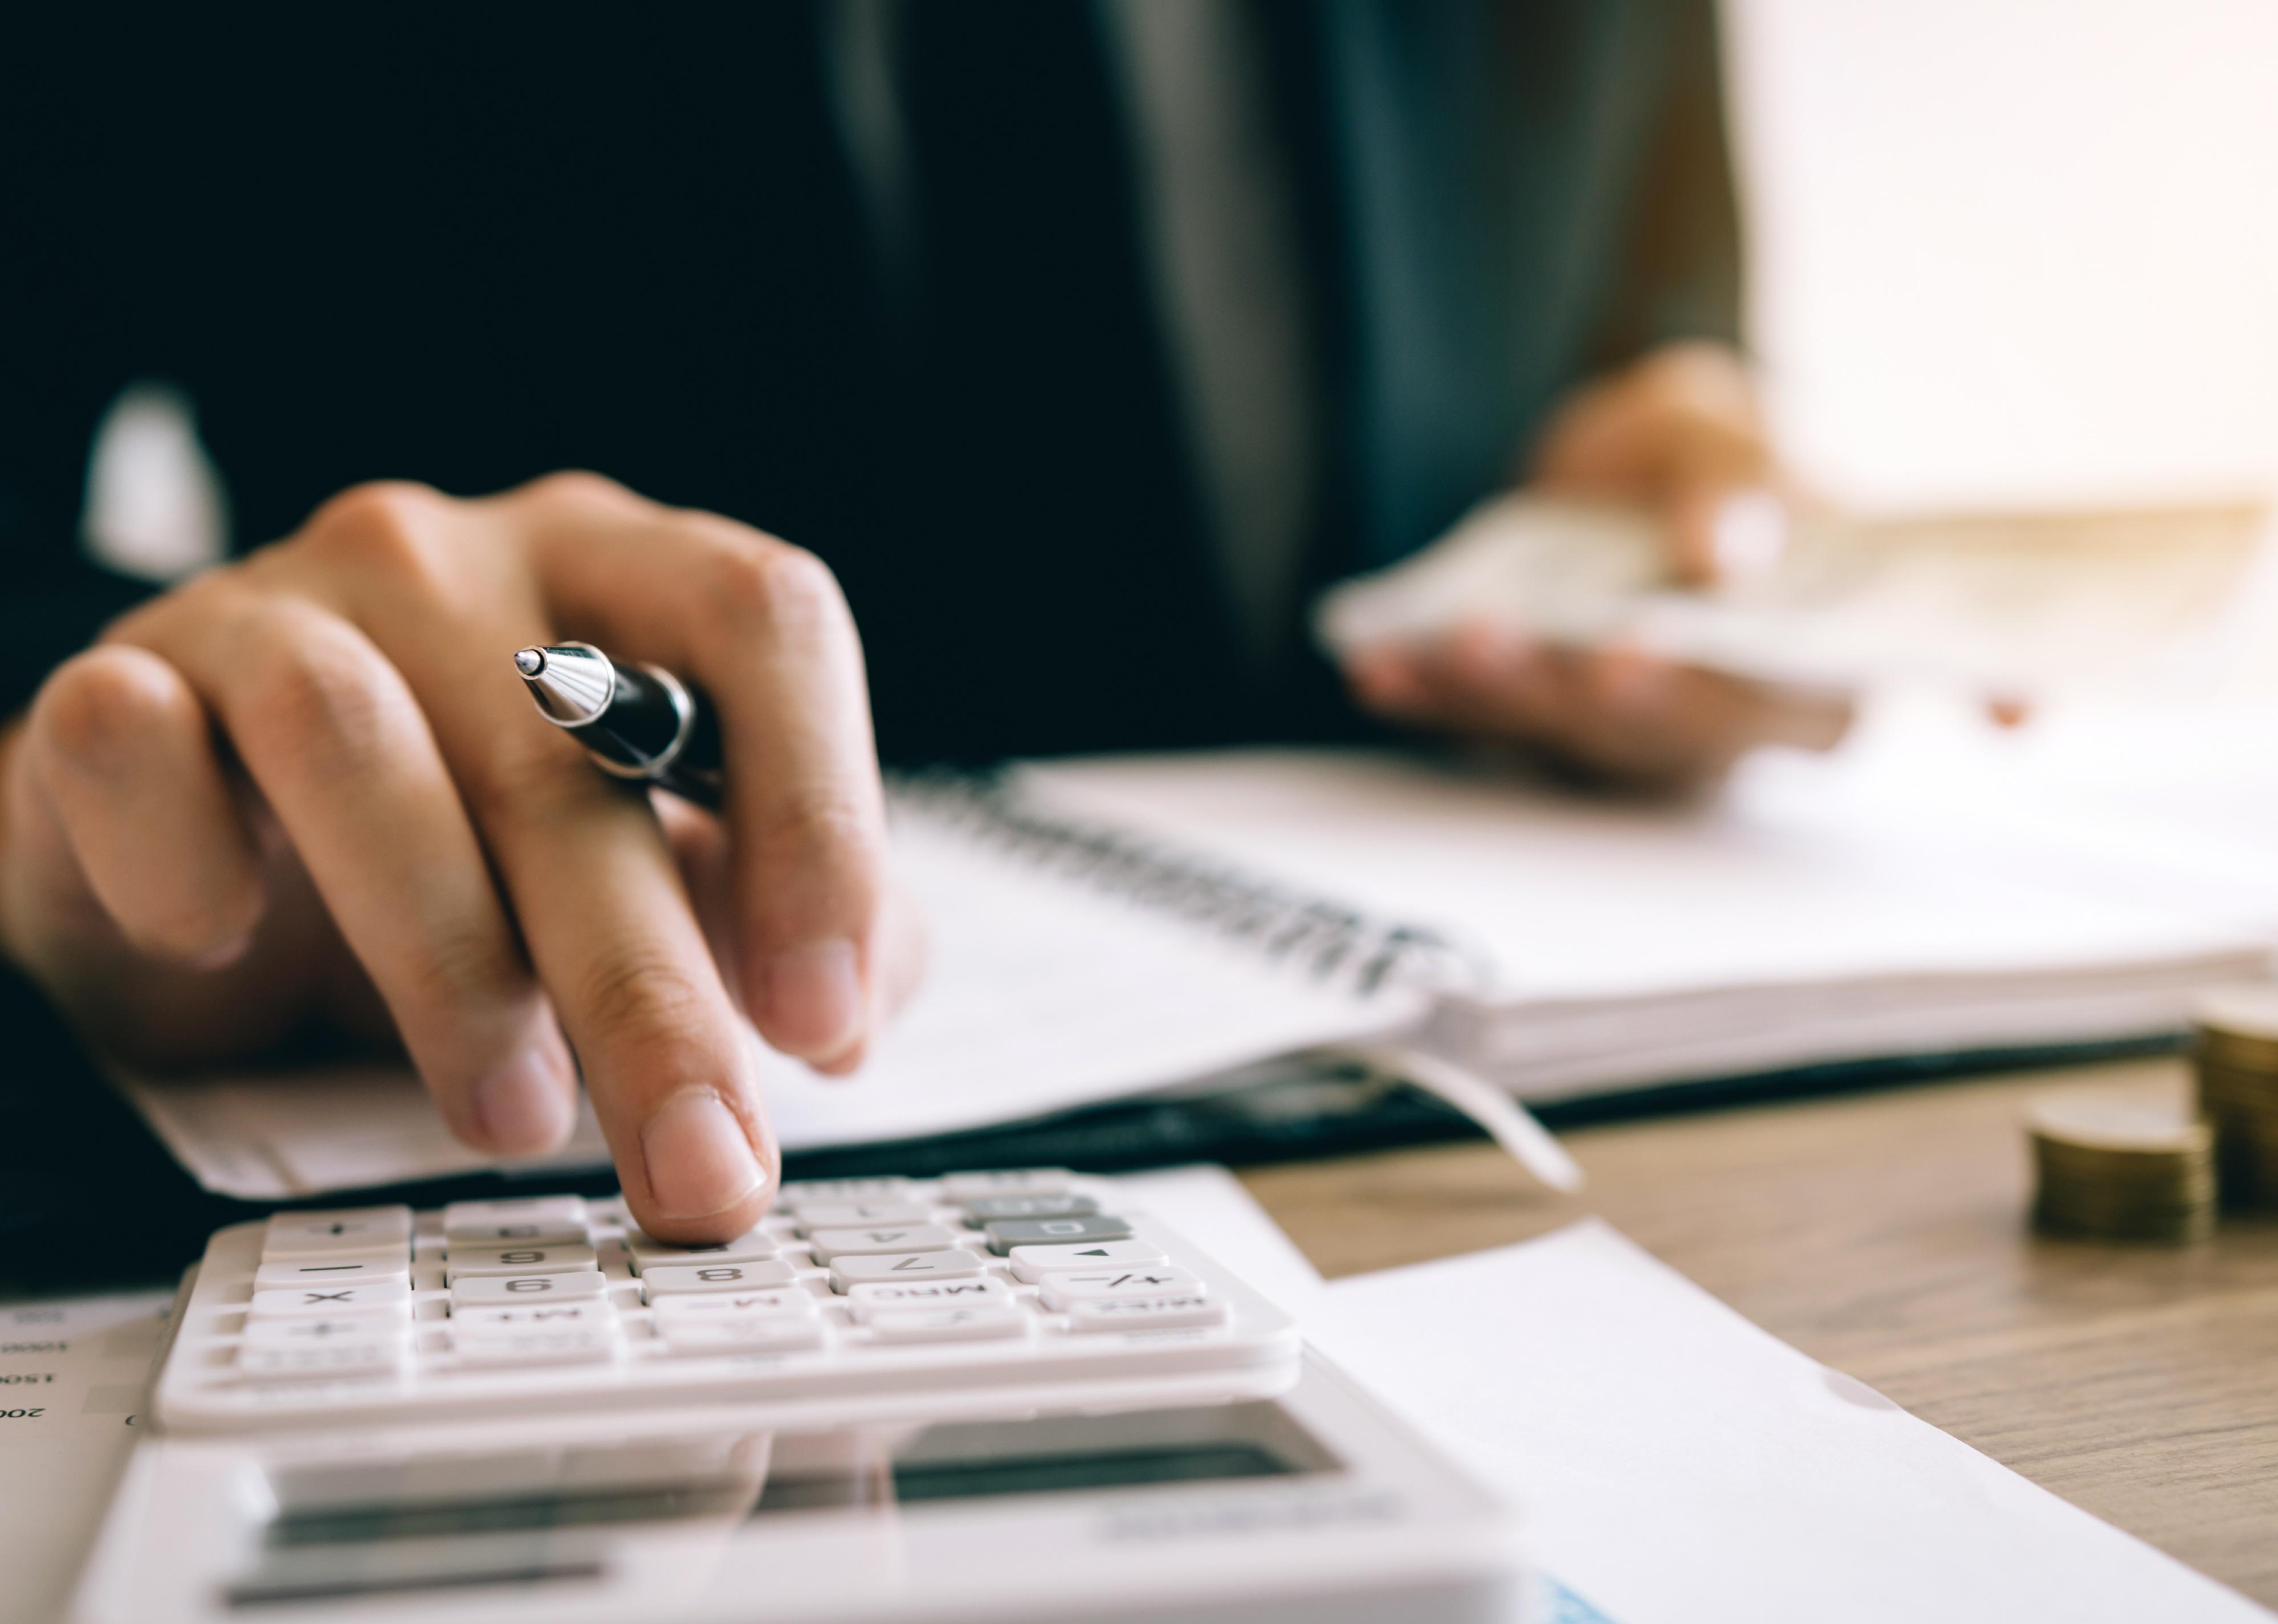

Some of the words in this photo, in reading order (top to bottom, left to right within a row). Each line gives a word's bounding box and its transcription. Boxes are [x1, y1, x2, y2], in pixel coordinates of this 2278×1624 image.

[500, 1251, 545, 1264] 6
[891, 1257, 934, 1270] 7
[696, 1268, 743, 1282] 8
[506, 1279, 552, 1292] 9
